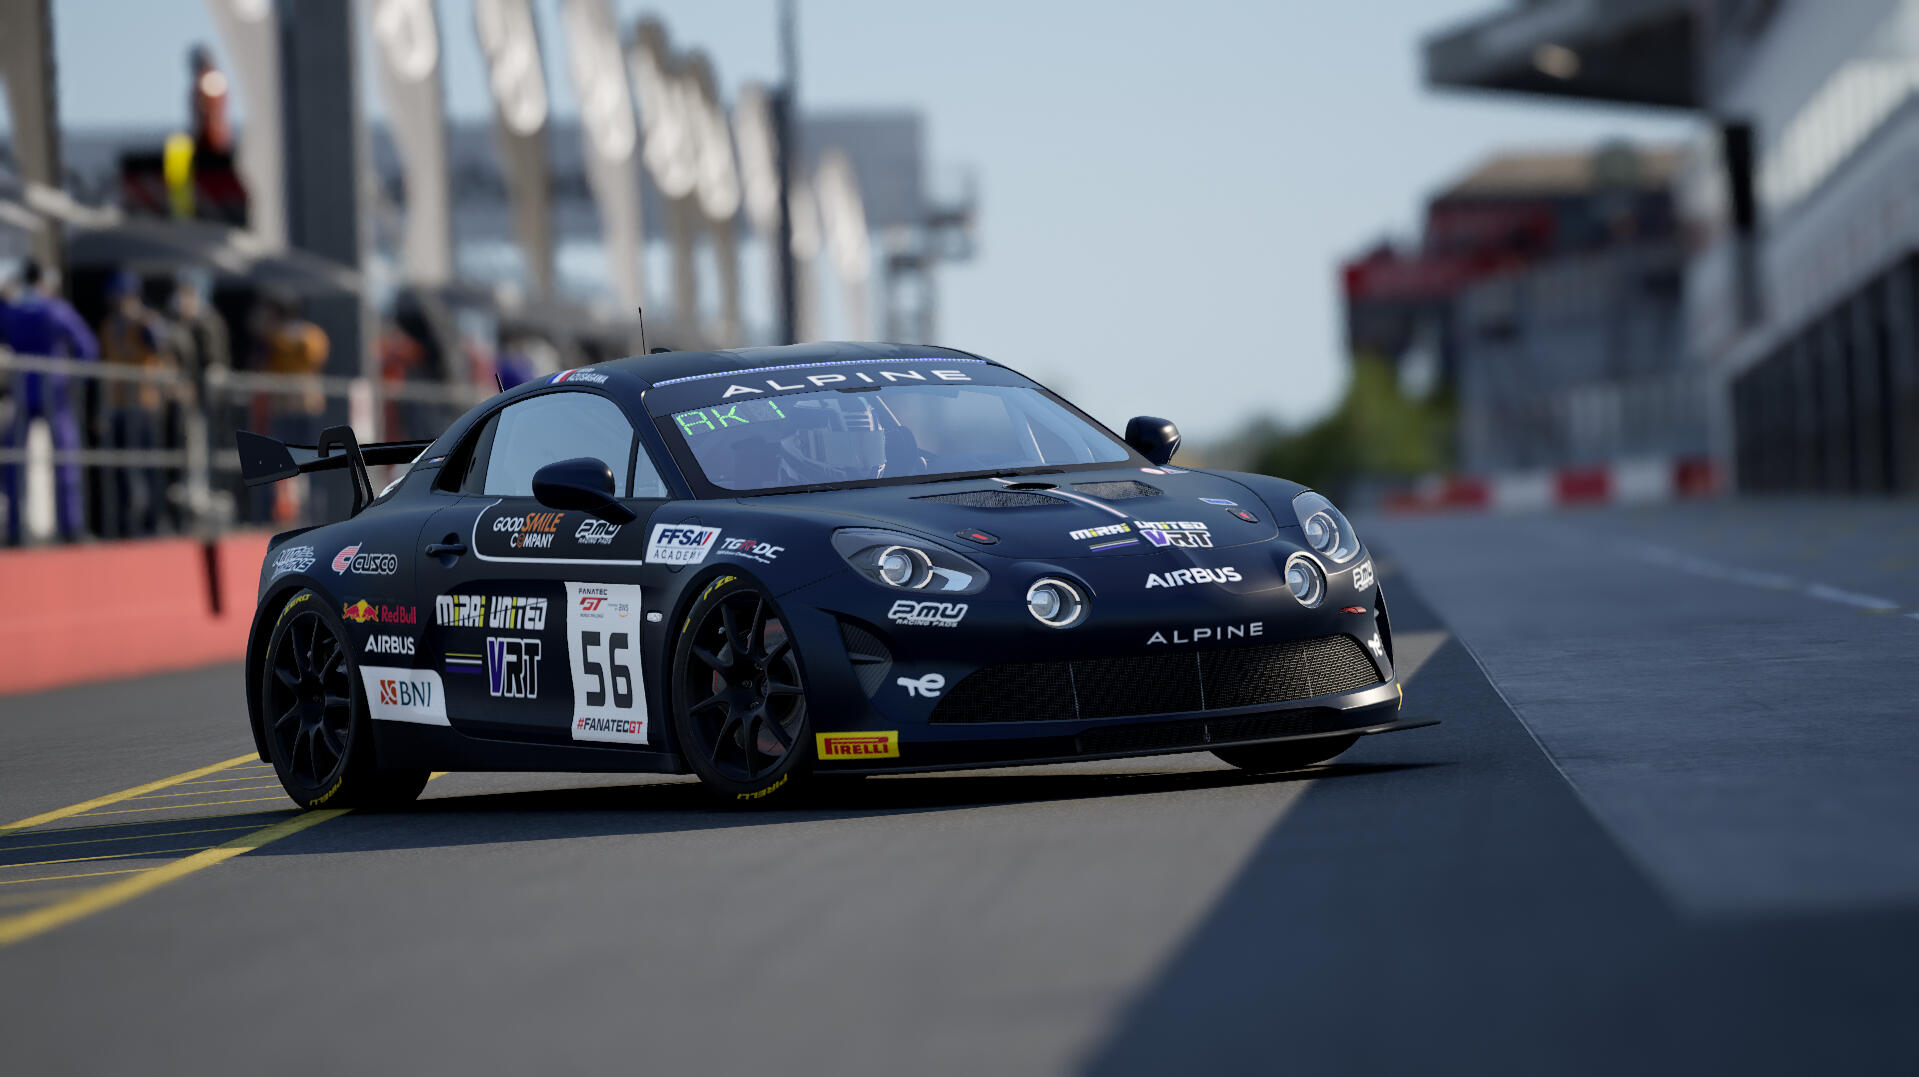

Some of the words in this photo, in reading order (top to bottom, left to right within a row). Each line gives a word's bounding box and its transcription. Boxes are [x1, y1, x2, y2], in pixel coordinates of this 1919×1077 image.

[722, 369, 972, 399] ALPINE
[676, 405, 750, 436] AK
[493, 517, 525, 532] GOOD
[520, 513, 566, 533] SMILE
[510, 533, 555, 548] COMPANY
[656, 528, 704, 547] FFSA
[1139, 529, 1214, 548] VRT
[351, 553, 398, 575] CUSCO
[1145, 566, 1243, 589] AIRBUS
[579, 587, 609, 596] FANATEC
[381, 604, 399, 623] Red
[400, 605, 417, 625] Bull
[580, 597, 608, 612] GT
[896, 618, 931, 626] RACING
[932, 619, 958, 628] PADS
[1146, 622, 1263, 645] ALPINE
[364, 634, 415, 655] AIRBUS
[487, 637, 542, 699] VRT
[582, 631, 634, 709] 56
[399, 680, 431, 708] BNI
[576, 717, 643, 734] #FANATECGT
[824, 736, 889, 755] PIRELLI
